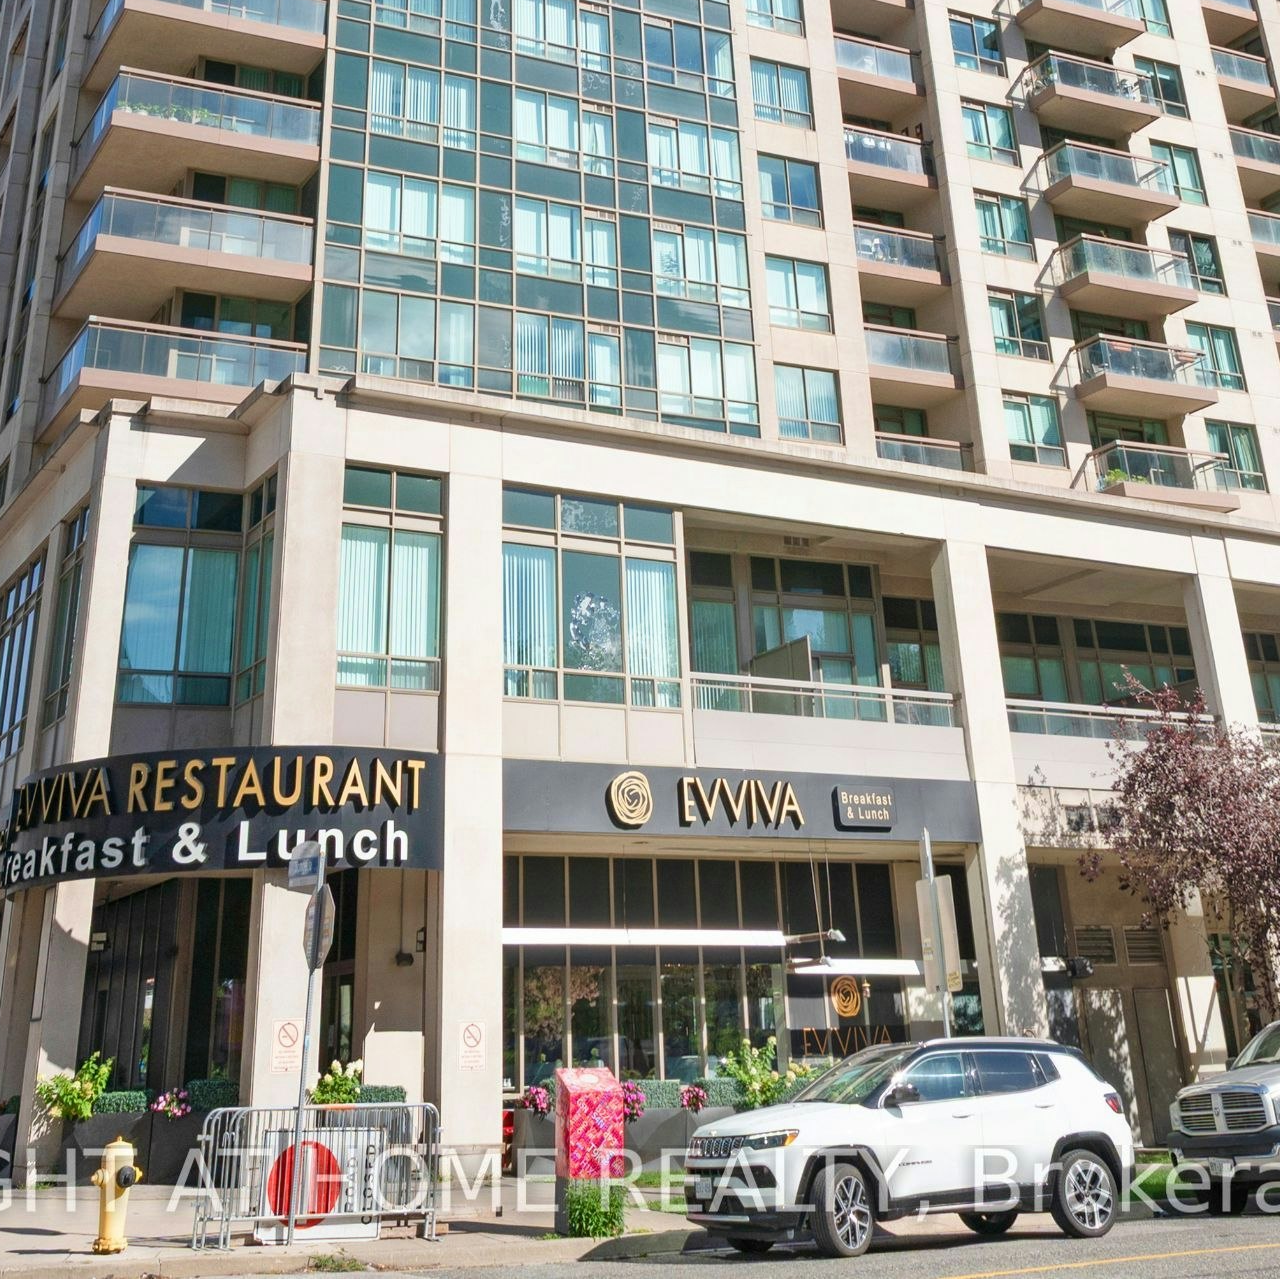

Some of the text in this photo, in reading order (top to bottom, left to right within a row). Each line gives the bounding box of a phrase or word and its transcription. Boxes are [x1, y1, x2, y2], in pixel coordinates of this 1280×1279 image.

[15, 755, 426, 832] EVVIVA RESTAURANT
[682, 776, 805, 825] EVVIVA
[841, 791, 893, 806] Breakfast
[847, 807, 890, 821] & Lunch
[2, 819, 409, 885] reakfast & Lunch
[803, 1023, 893, 1057] EVVIVA
